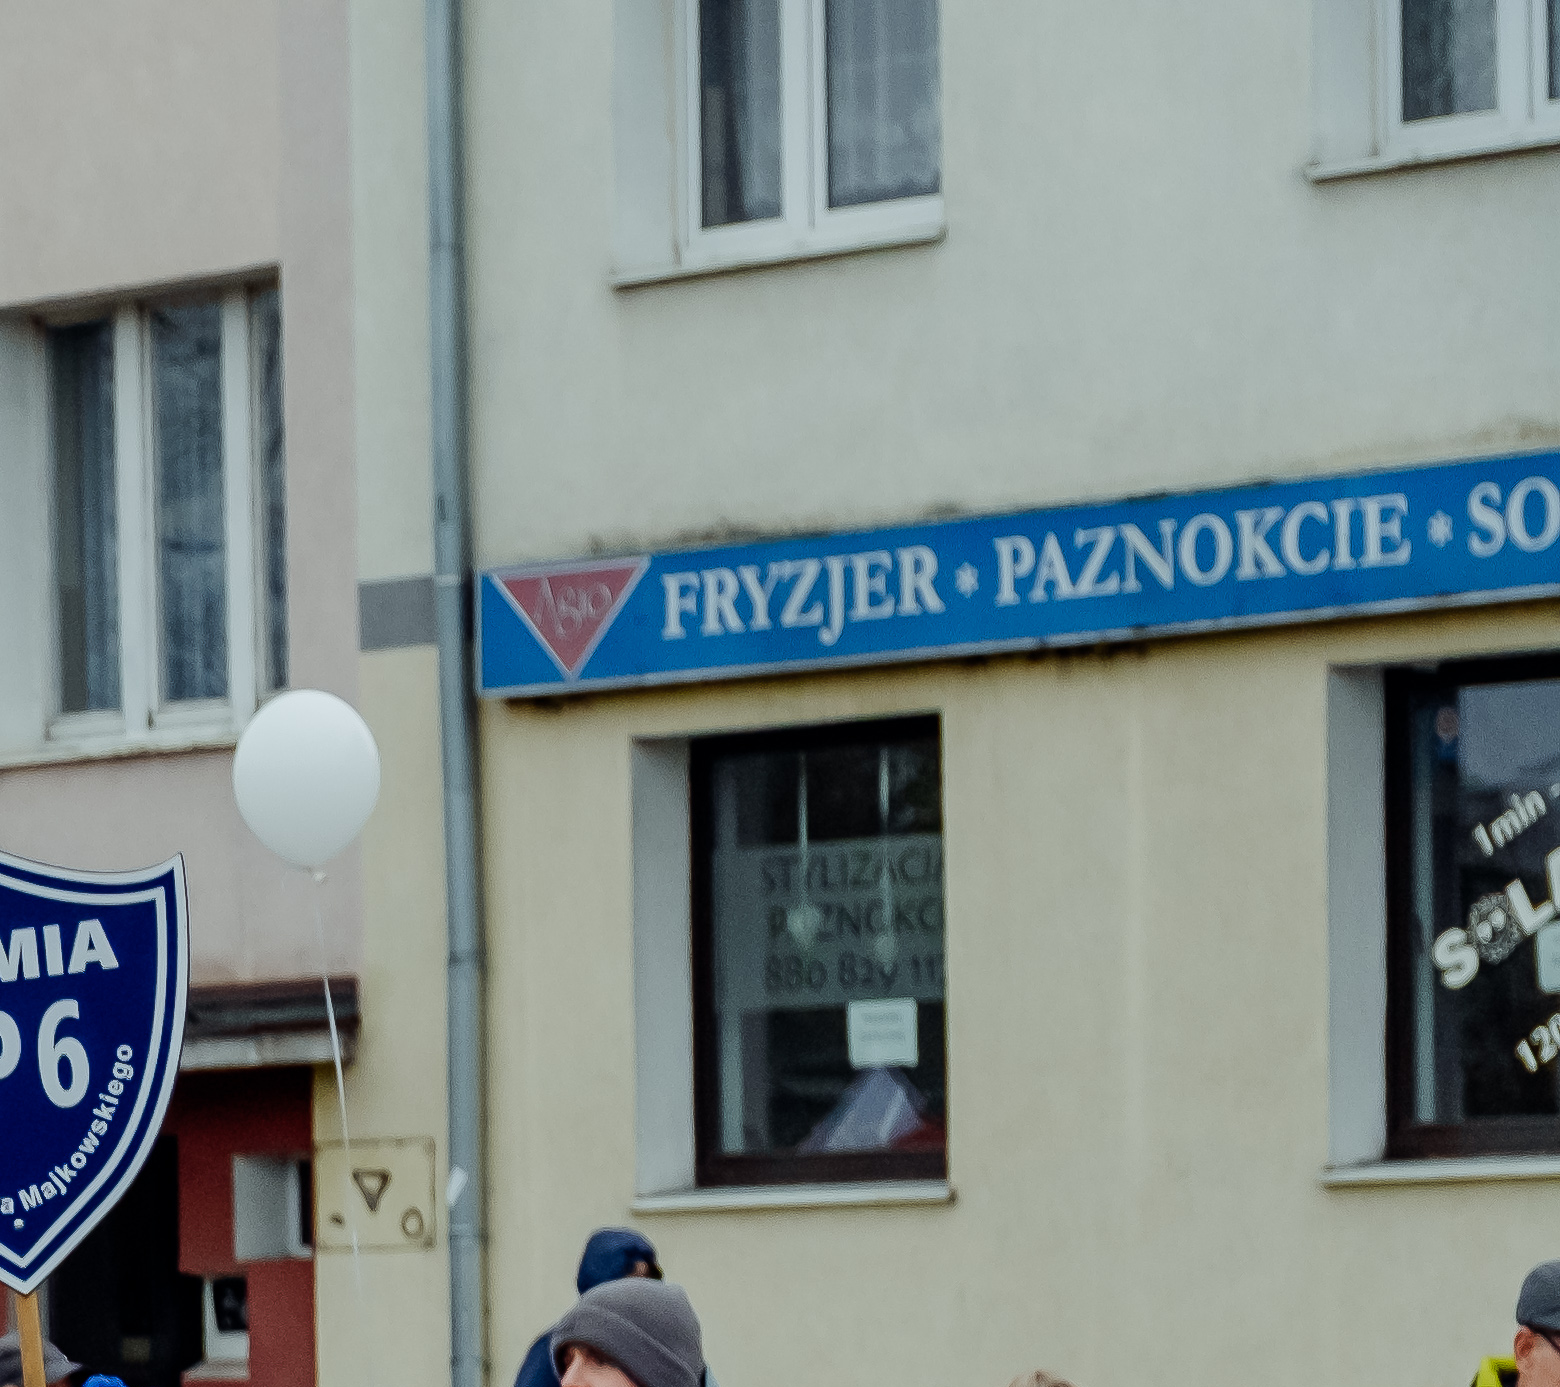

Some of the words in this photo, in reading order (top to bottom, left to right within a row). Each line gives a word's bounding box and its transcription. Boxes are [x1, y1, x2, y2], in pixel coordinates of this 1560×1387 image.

[661, 545, 947, 647] FRYZJER
[993, 492, 1412, 606] PAZNOKCIE
[1466, 475, 1560, 558] SO
[17, 1044, 134, 1212] Majkowskiego
[37, 998, 91, 1109] 6
